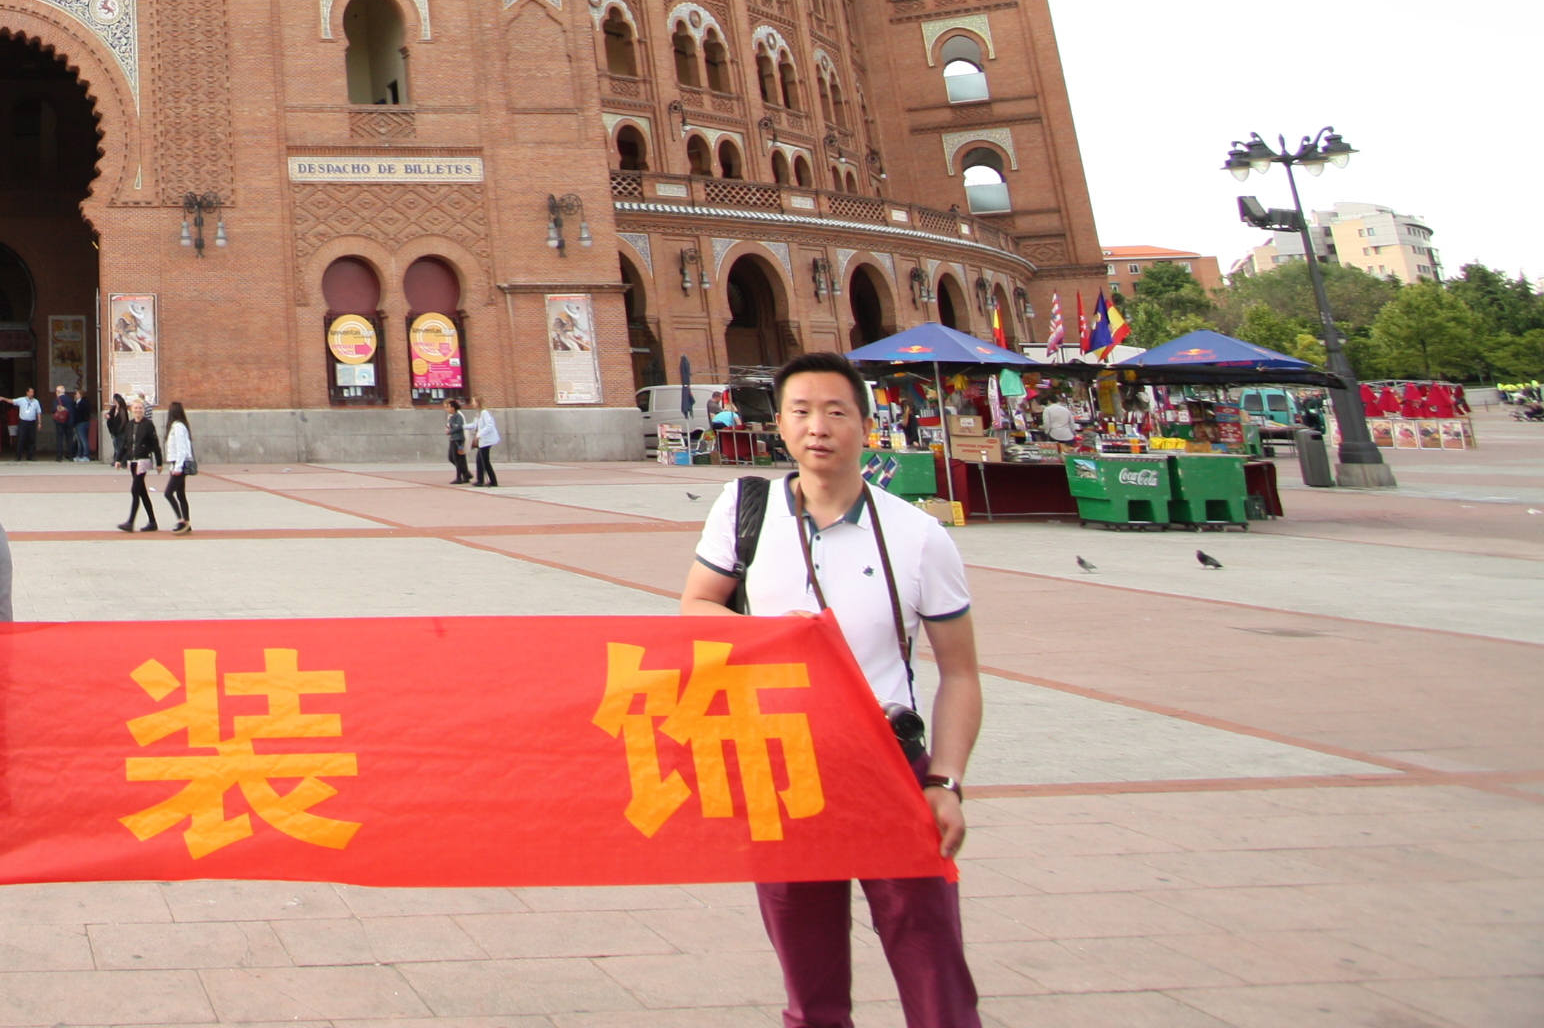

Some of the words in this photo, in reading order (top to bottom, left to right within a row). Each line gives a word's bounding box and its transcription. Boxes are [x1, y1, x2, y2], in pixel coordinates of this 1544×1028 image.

[297, 163, 371, 175] DESPACHO
[378, 163, 395, 175] DE
[404, 163, 473, 176] BILLETES
